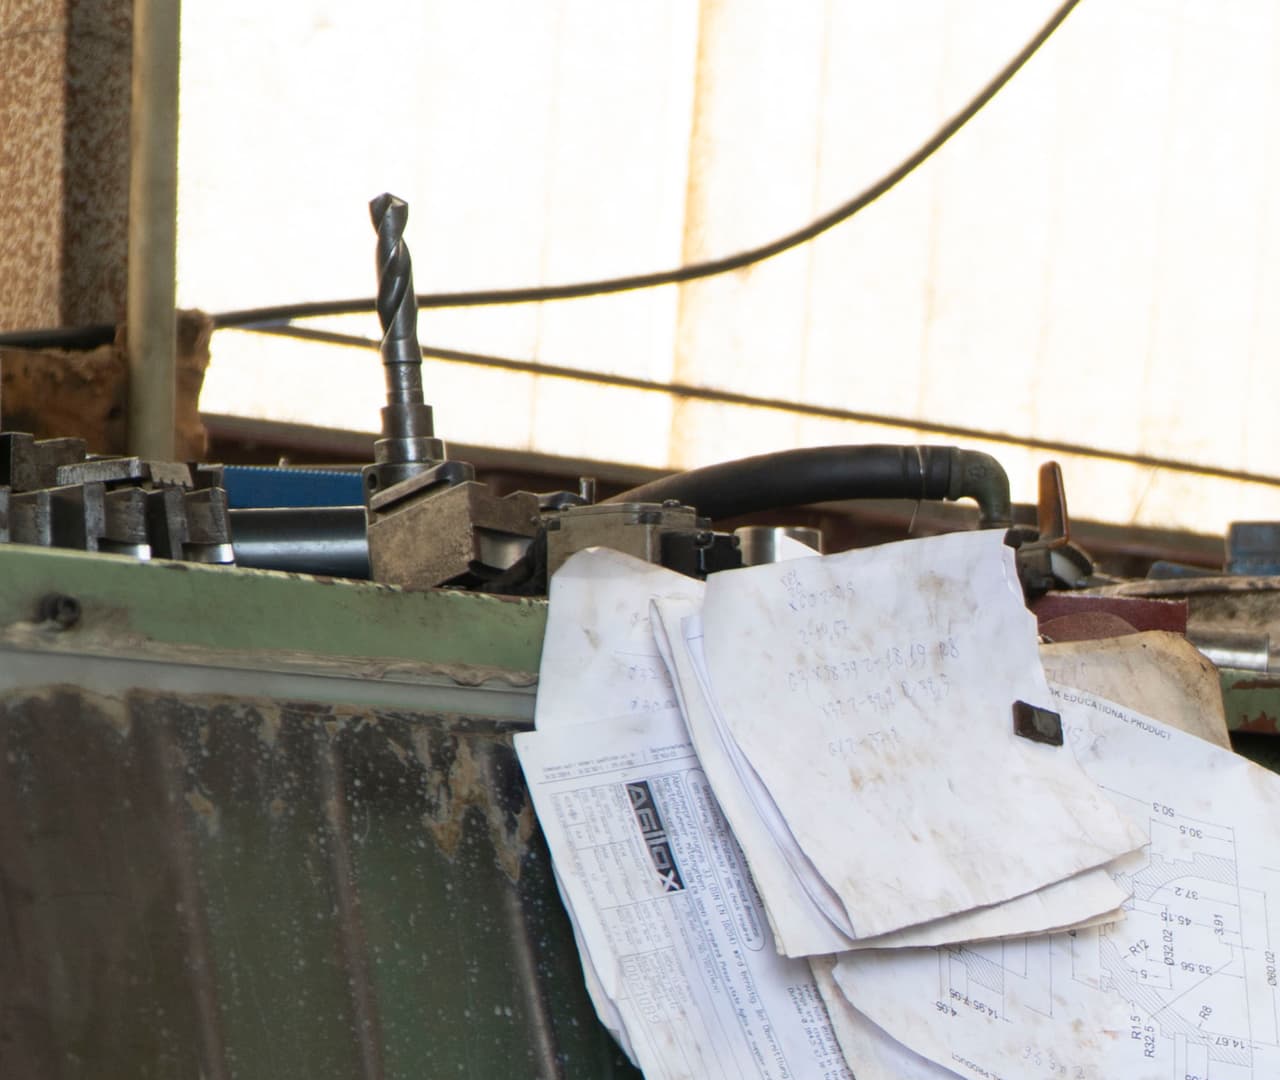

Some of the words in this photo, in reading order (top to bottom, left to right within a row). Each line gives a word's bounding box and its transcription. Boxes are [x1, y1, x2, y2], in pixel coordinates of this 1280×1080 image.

[1062, 693, 1129, 722] EDUCATIONAL
[1129, 717, 1172, 740] PRODUCT
[1153, 804, 1175, 817] 50.3
[1179, 825, 1203, 839] 30.5
[1174, 886, 1199, 900] 37.2
[1160, 912, 1192, 926] 45.15
[1214, 914, 1225, 936] 3.91
[1129, 939, 1149, 957] R12
[1140, 970, 1148, 979] 5
[1180, 960, 1213, 976] 33.56
[1199, 1005, 1213, 1021] R8
[1132, 1015, 1141, 1040] R1.5
[1144, 1025, 1156, 1058] R32.5
[1215, 1037, 1246, 1049] 14.67
